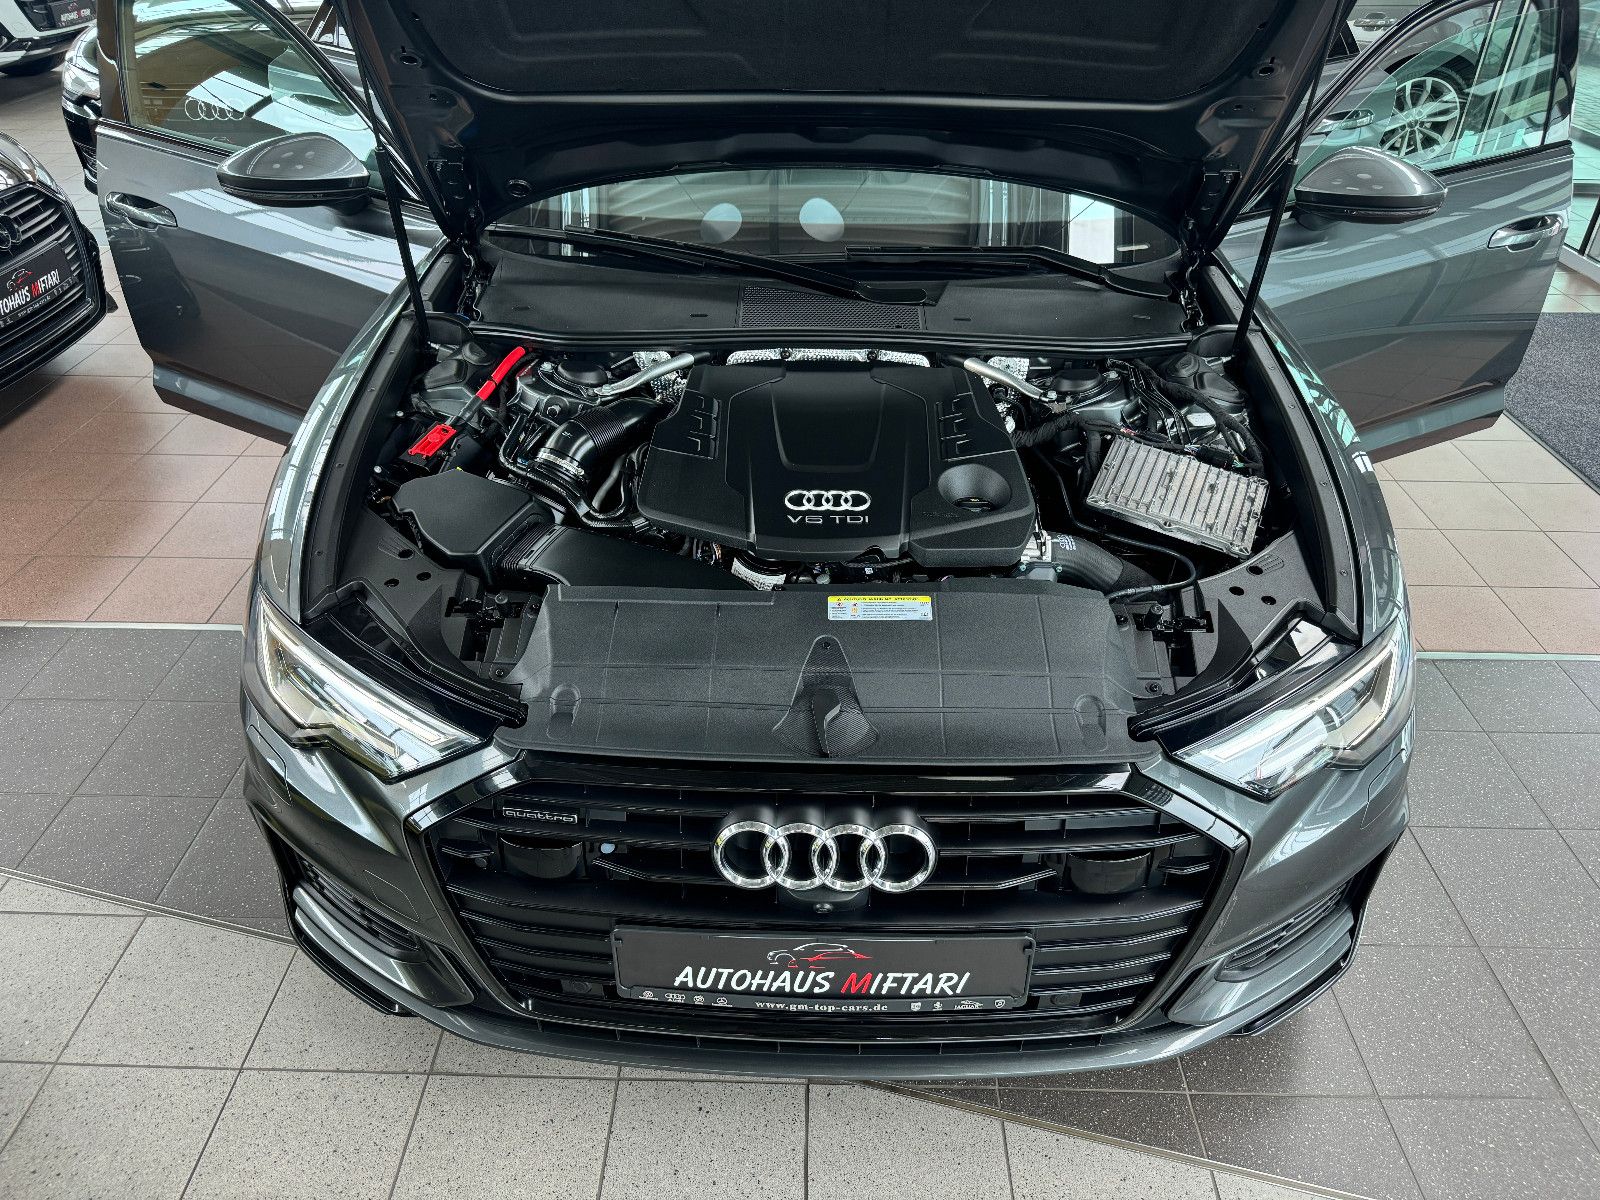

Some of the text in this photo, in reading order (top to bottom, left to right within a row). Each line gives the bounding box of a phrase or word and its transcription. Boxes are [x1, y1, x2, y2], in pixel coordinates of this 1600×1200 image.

[31, 269, 60, 298] MIFTARI
[787, 515, 869, 524] V6 TDI
[506, 810, 574, 821] quattro
[673, 965, 971, 995] AUTOHAUS MIFTARI
[755, 1001, 888, 1012] www.gm-top-cars.de
